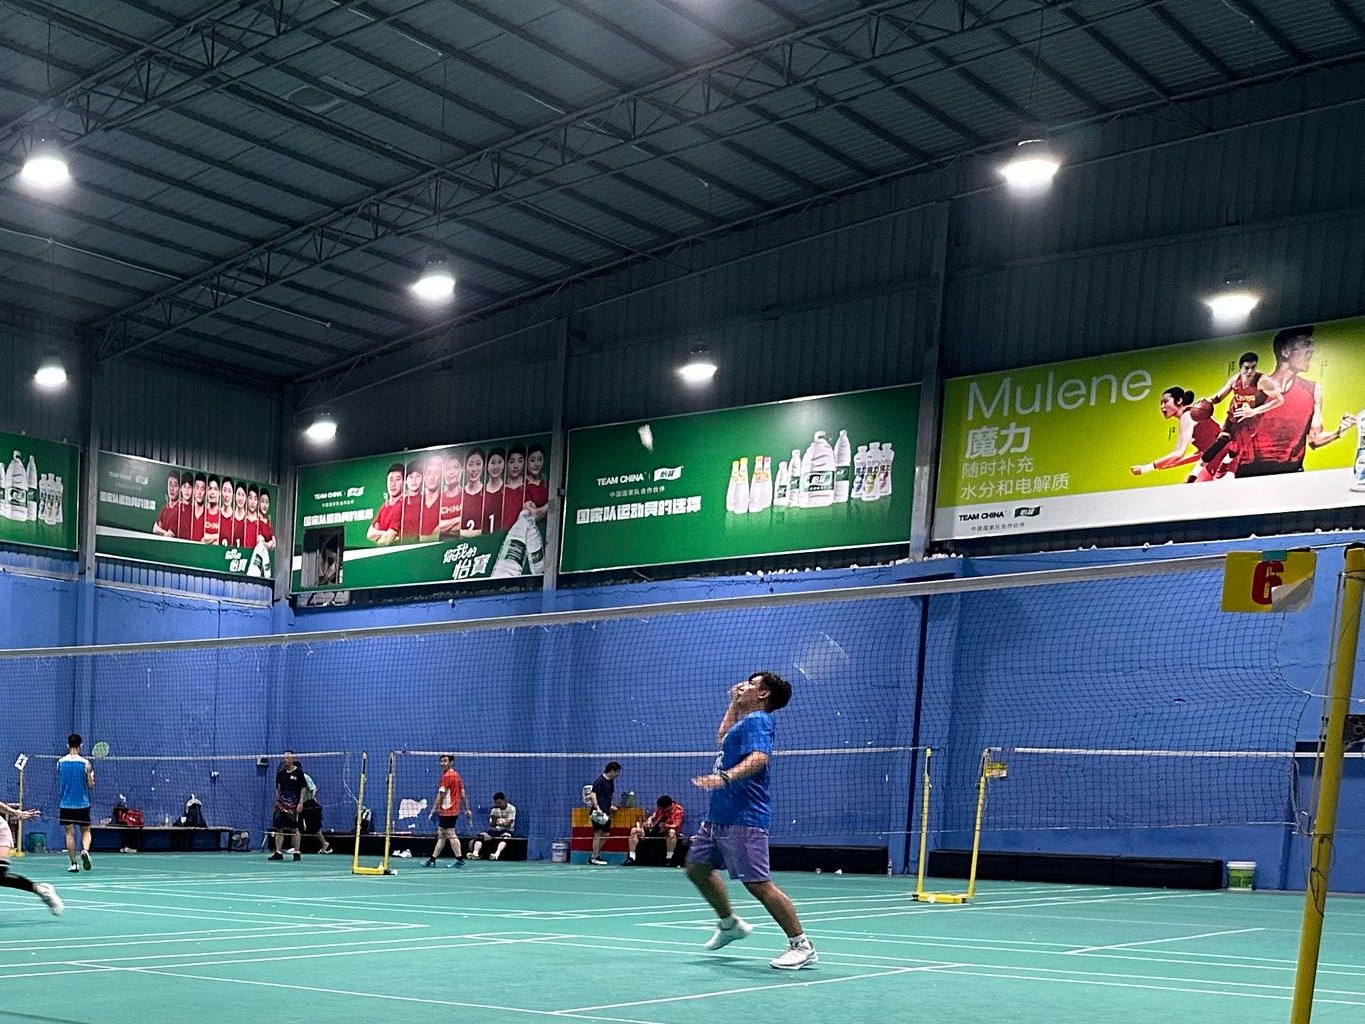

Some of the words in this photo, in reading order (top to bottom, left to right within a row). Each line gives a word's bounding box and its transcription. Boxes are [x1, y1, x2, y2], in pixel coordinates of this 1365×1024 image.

[967, 369, 1153, 421] Mulene
[964, 422, 1031, 459] 魔力
[597, 477, 619, 486] TEAM
[619, 473, 644, 484] CHINA
[962, 456, 1034, 479] 随时补充
[960, 472, 1070, 500] 水分和电解质
[959, 513, 980, 521] TEAM
[981, 511, 1004, 520] CHINA
[1251, 560, 1284, 605] 6
